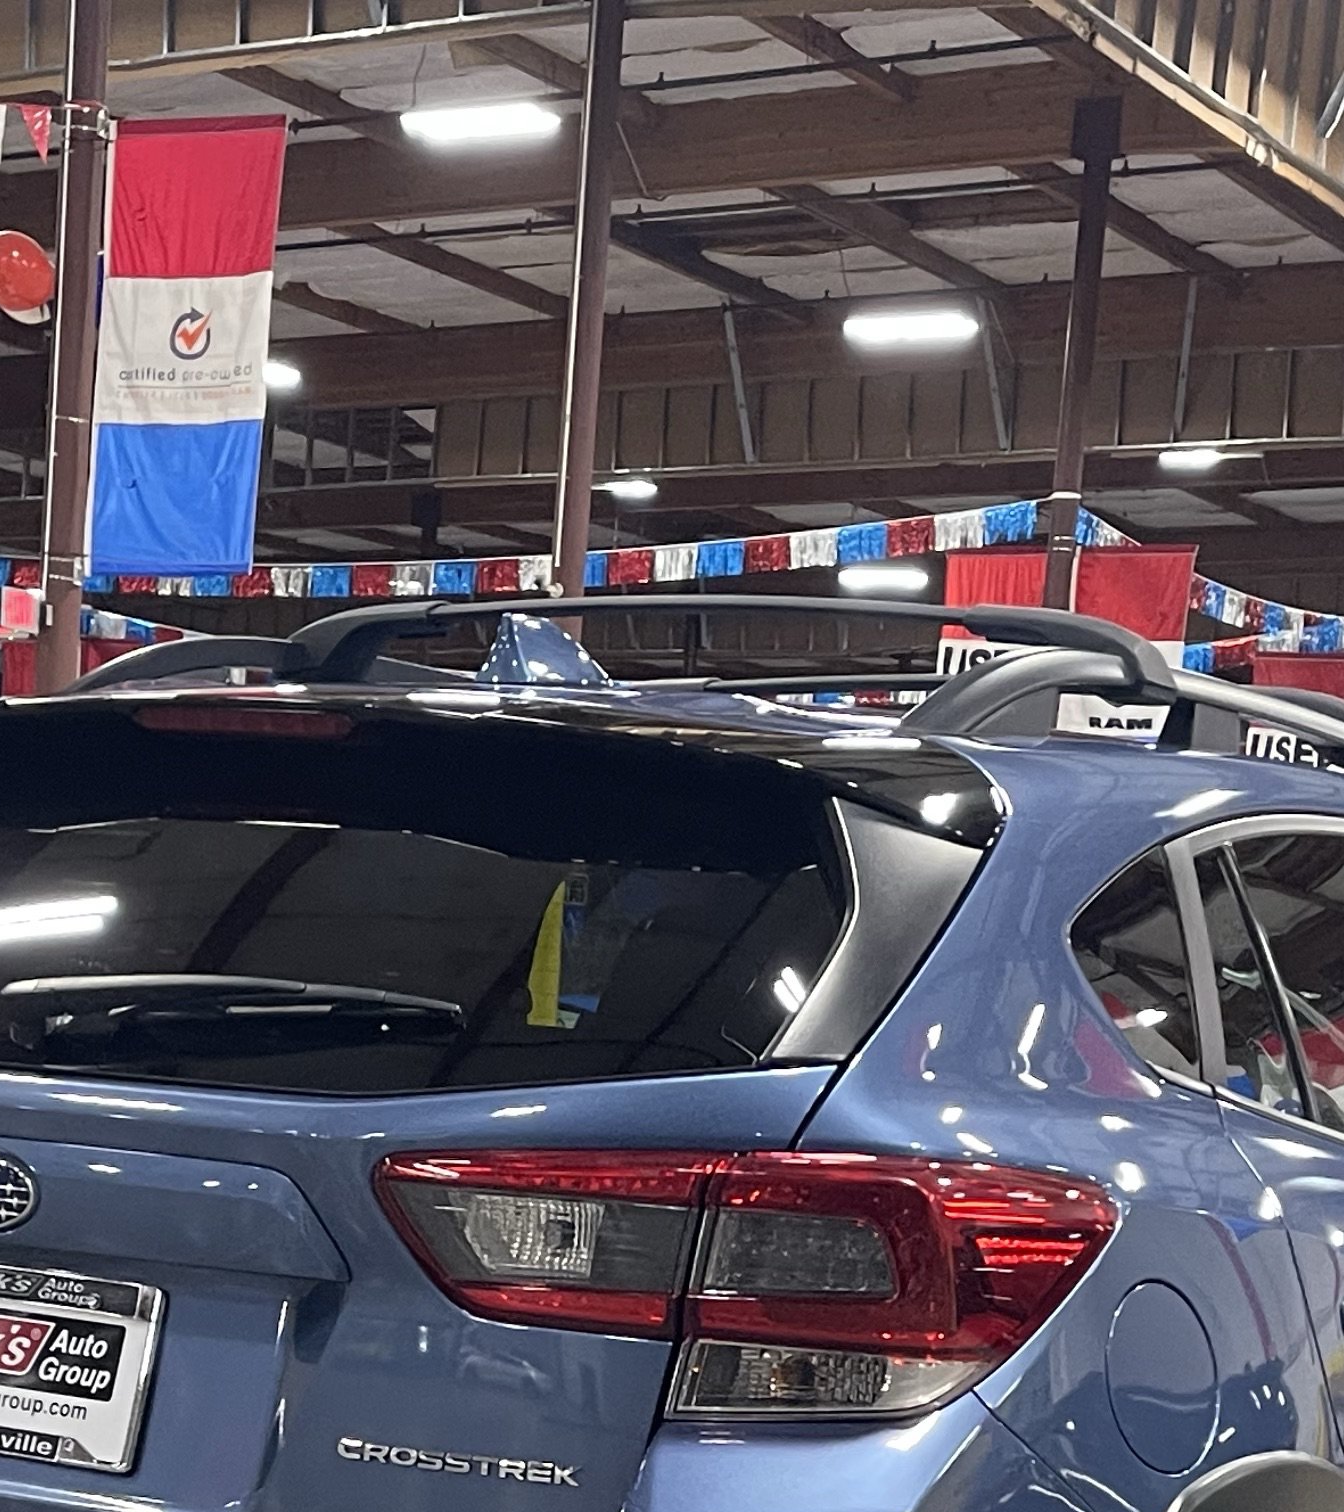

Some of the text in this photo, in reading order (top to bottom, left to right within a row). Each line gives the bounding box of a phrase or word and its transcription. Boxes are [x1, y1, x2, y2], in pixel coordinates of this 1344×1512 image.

[1089, 716, 1153, 730] RAM
[44, 1278, 85, 1294] Auto
[49, 1329, 109, 1360] Auto
[38, 1358, 111, 1394] Group
[337, 1437, 582, 1488] CROSSTREK
